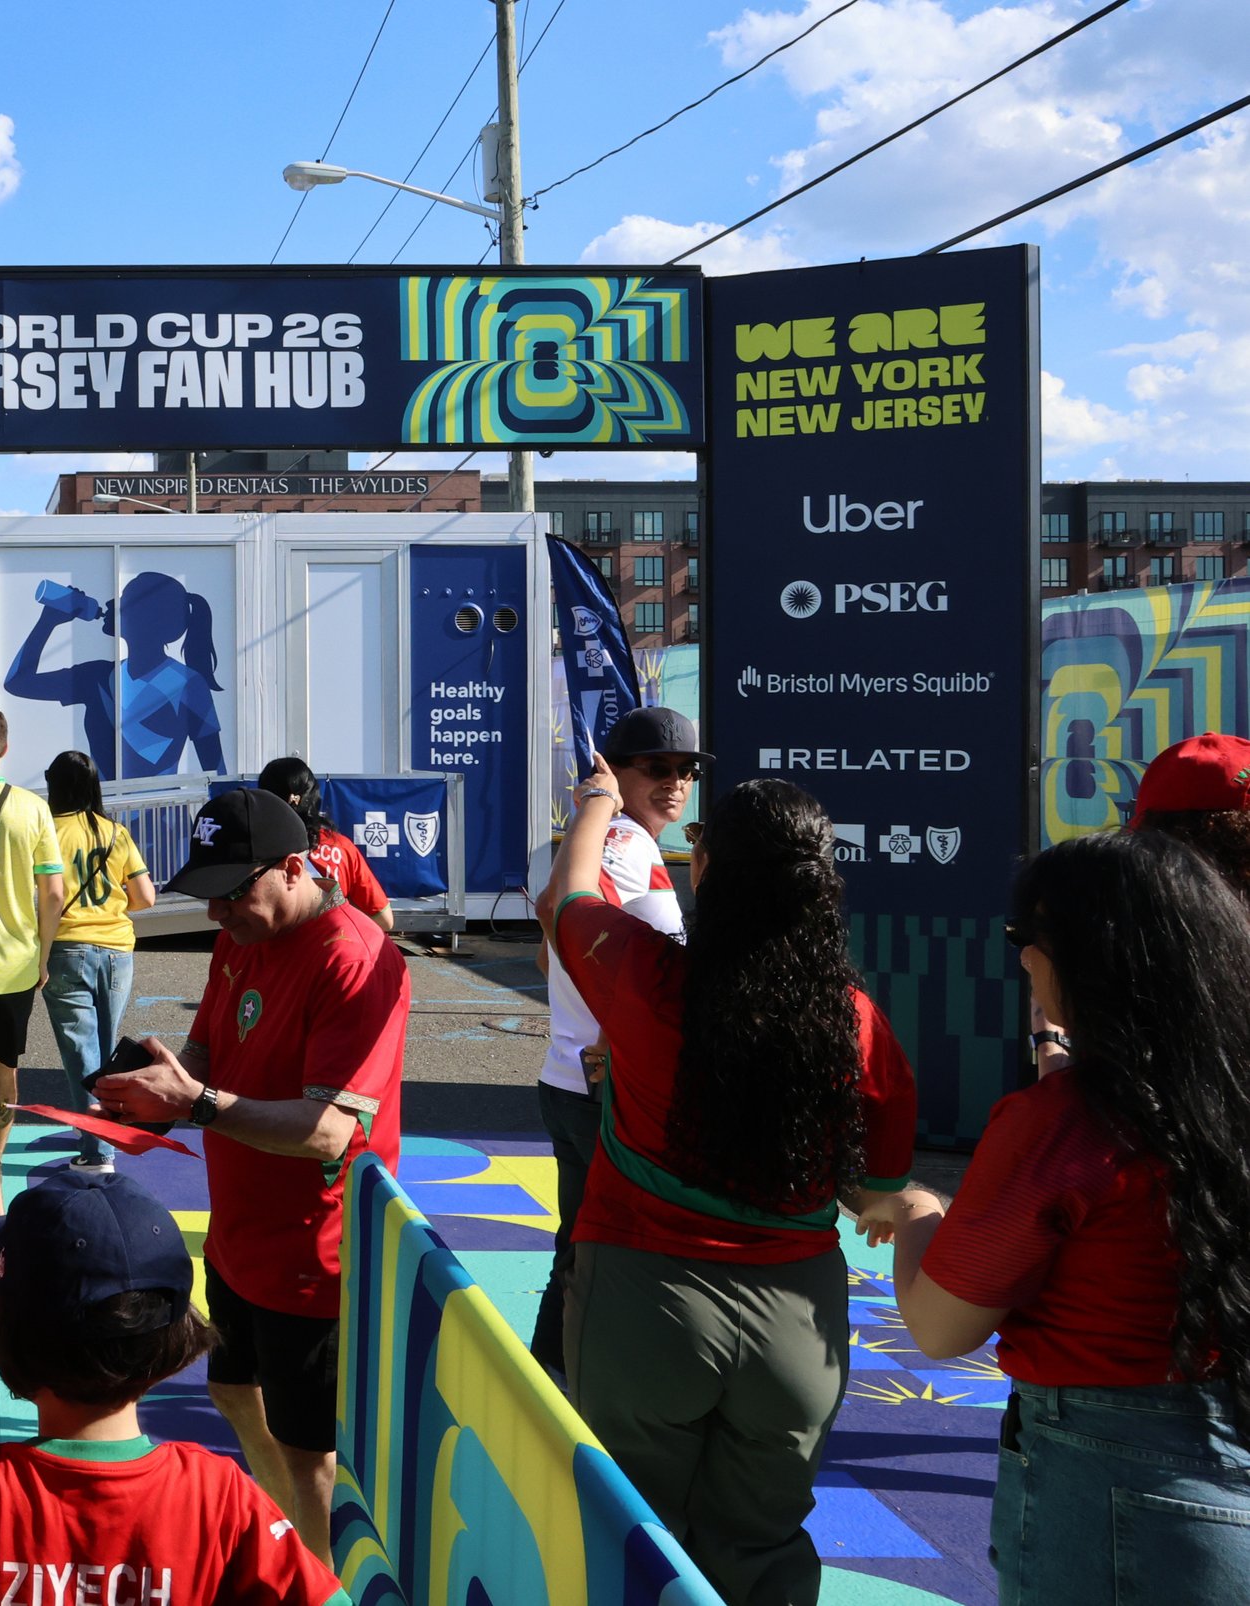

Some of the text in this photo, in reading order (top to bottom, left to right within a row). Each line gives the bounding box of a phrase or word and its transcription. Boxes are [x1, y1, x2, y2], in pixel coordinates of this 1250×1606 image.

[147, 312, 273, 348] CUP
[282, 312, 363, 348] 26
[735, 302, 986, 362] WE ARE
[137, 350, 243, 409] FAN
[254, 350, 366, 409] HUB
[736, 353, 986, 401] NEW YORK
[736, 391, 986, 438] NEW JERSEY
[95, 477, 427, 494] NEW INSPIRED RENTALS THE WYLDES
[803, 493, 924, 534] Uber
[835, 581, 948, 613] PSEG
[431, 681, 505, 704] Healthy
[767, 672, 989, 697] Bristol Myers Squibb
[431, 704, 482, 724] goals
[431, 725, 502, 748] happen
[431, 748, 480, 766] here.
[788, 748, 971, 772] RELATED
[192, 816, 222, 847] NY
[72, 847, 112, 908] 10
[0, 1561, 172, 1606] ZIYECH
